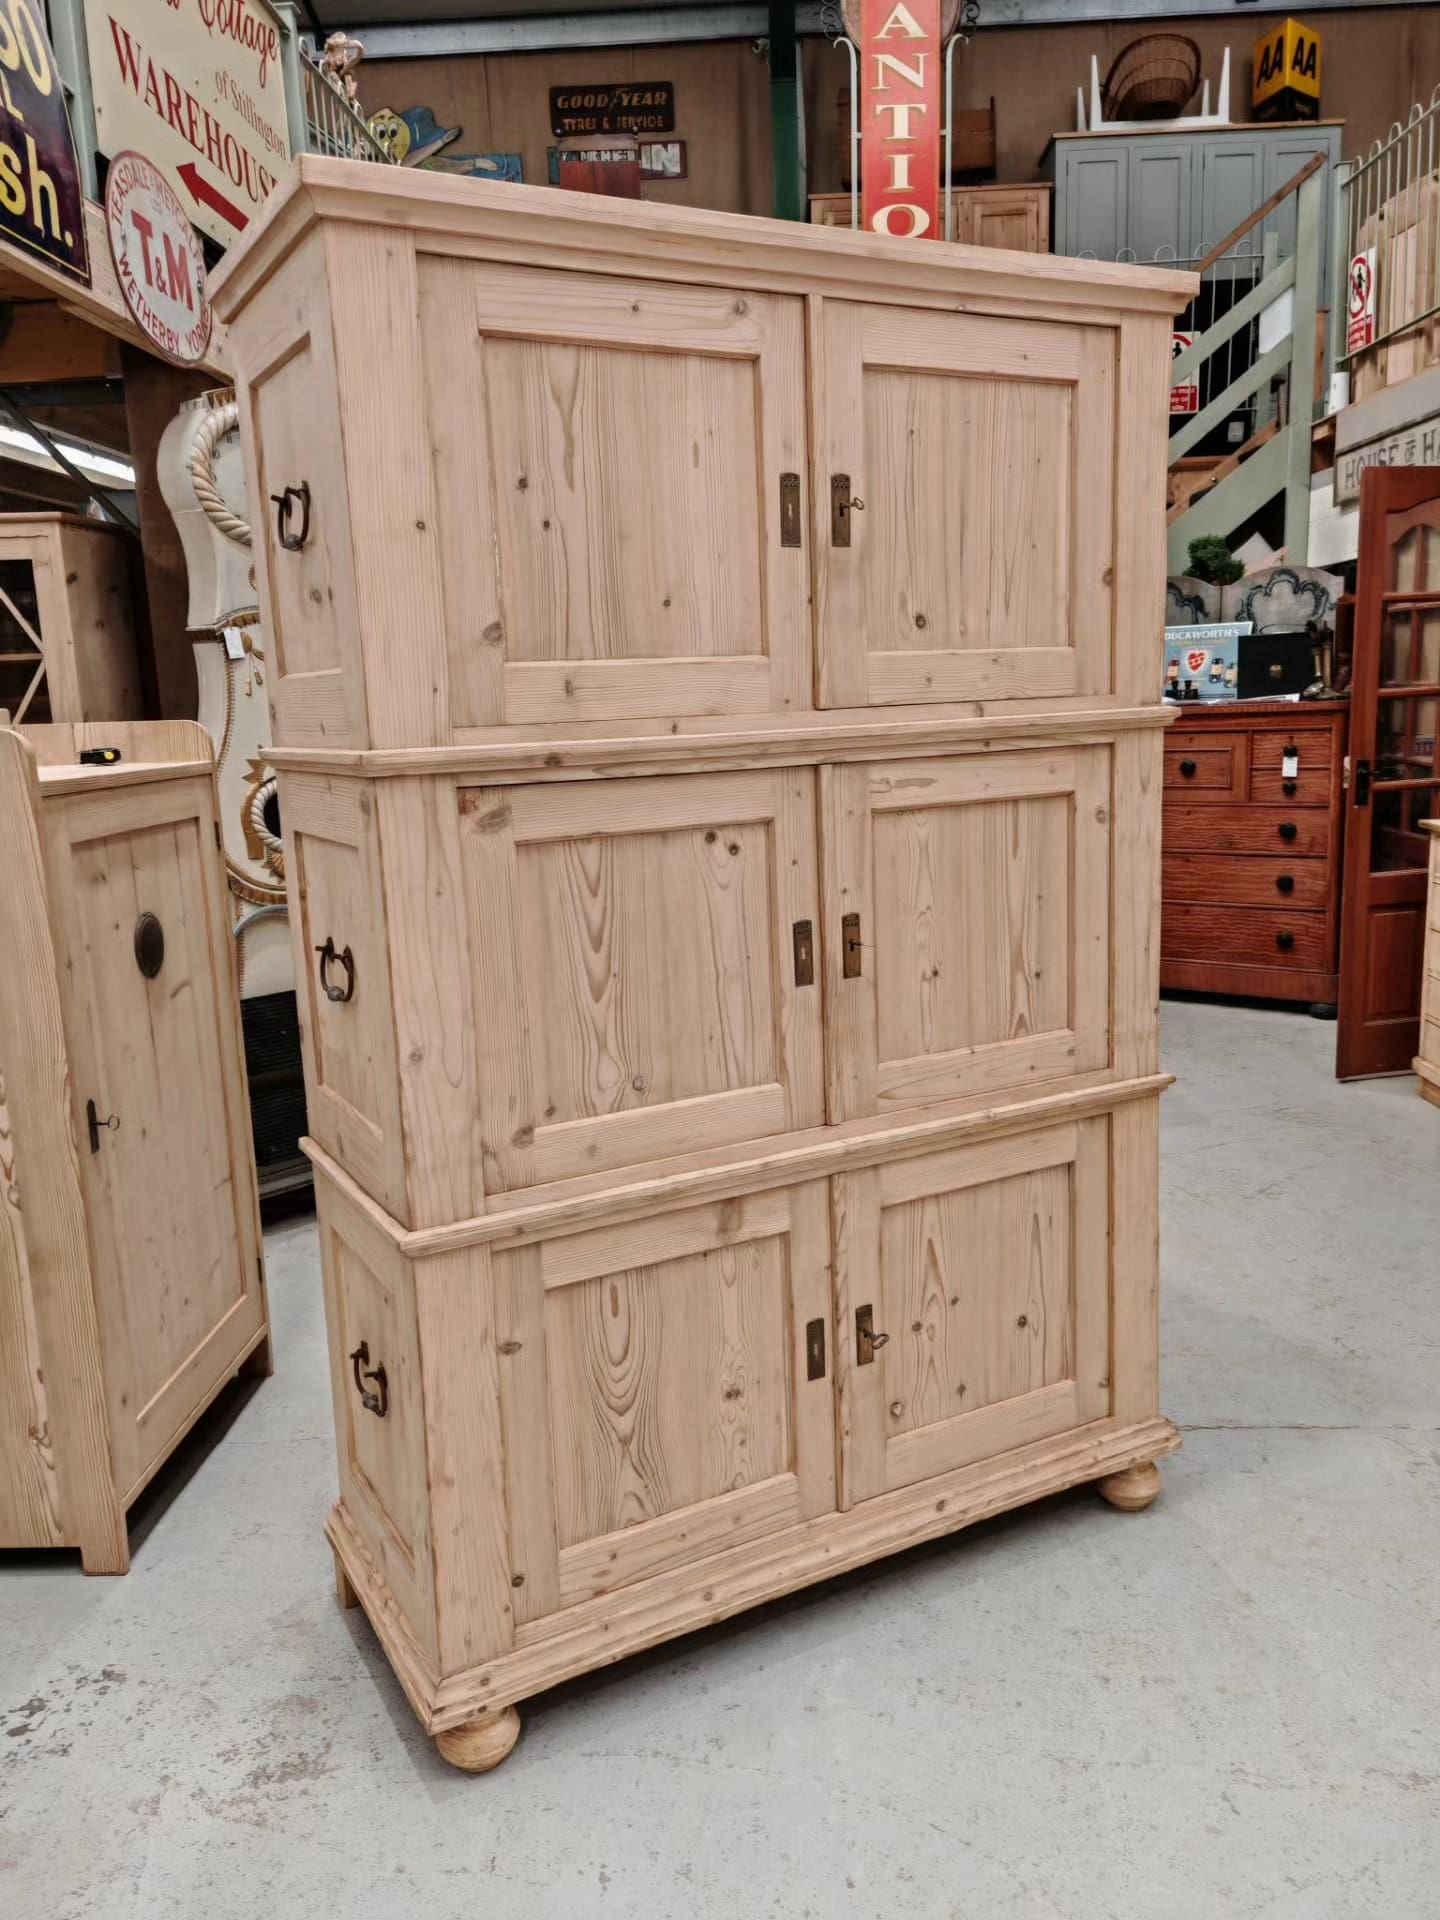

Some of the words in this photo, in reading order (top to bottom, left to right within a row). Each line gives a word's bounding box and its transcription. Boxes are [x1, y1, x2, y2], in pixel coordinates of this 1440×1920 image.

[1256, 35, 1284, 88] AA
[1292, 36, 1316, 80] AA
[108, 15, 280, 203] WAREHOUS
[230, 80, 287, 160] Stillington
[562, 117, 597, 131] TYRES
[617, 115, 664, 129] SERVICE
[112, 161, 150, 226] TEASDALE
